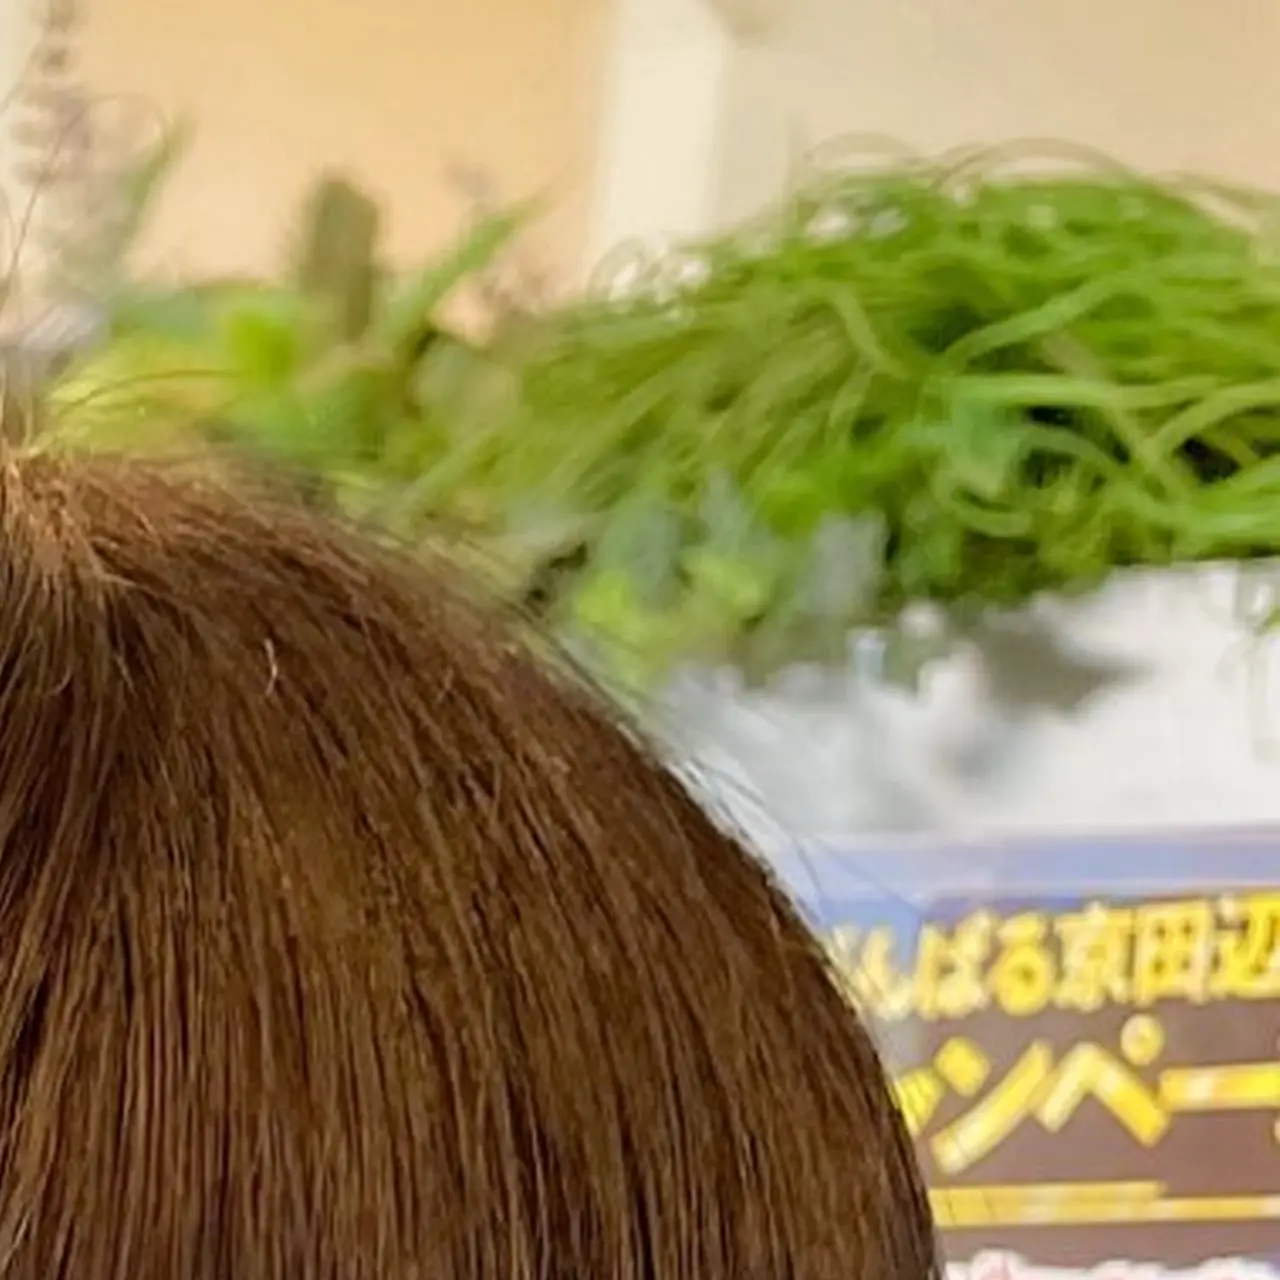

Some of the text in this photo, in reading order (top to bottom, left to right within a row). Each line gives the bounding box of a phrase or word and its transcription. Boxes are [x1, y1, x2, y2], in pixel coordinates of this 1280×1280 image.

[832, 893, 1280, 1020] んばる京田辺
